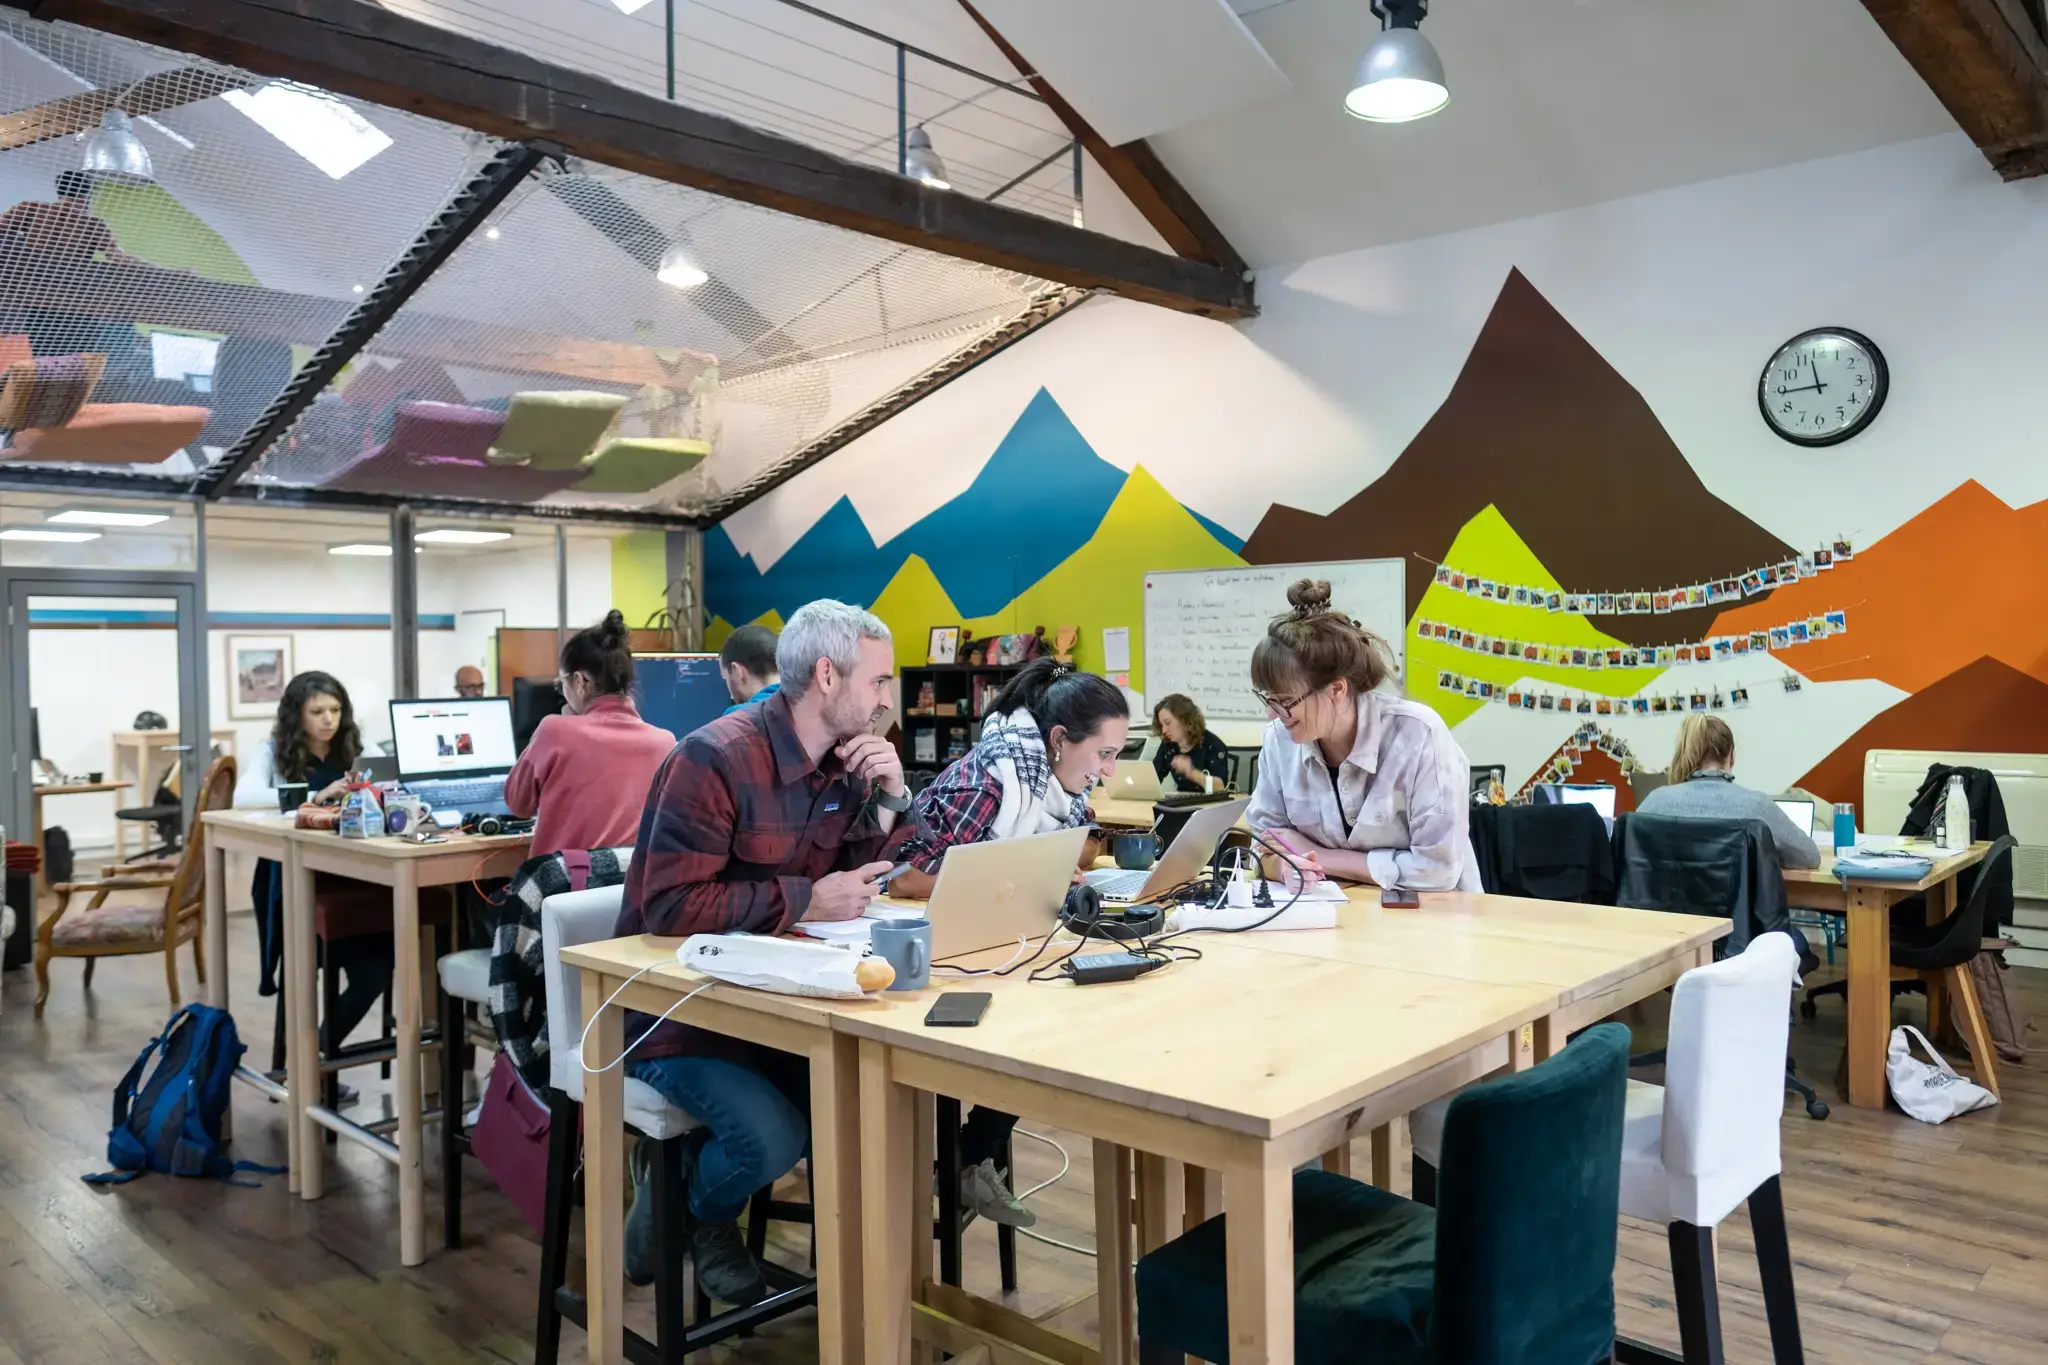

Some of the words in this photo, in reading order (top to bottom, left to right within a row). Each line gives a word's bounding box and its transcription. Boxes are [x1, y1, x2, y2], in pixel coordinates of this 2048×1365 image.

[1812, 348, 1827, 359] 12
[1795, 354, 1808, 367] 11
[1846, 357, 1856, 370] 2
[1783, 368, 1798, 381] 10
[1854, 374, 1863, 387] 3
[1777, 384, 1787, 396] 9
[1847, 392, 1857, 404] 4
[1783, 401, 1792, 413] 8
[1836, 406, 1845, 421] 5
[1798, 410, 1806, 422] 7
[1814, 412, 1825, 426] 6
